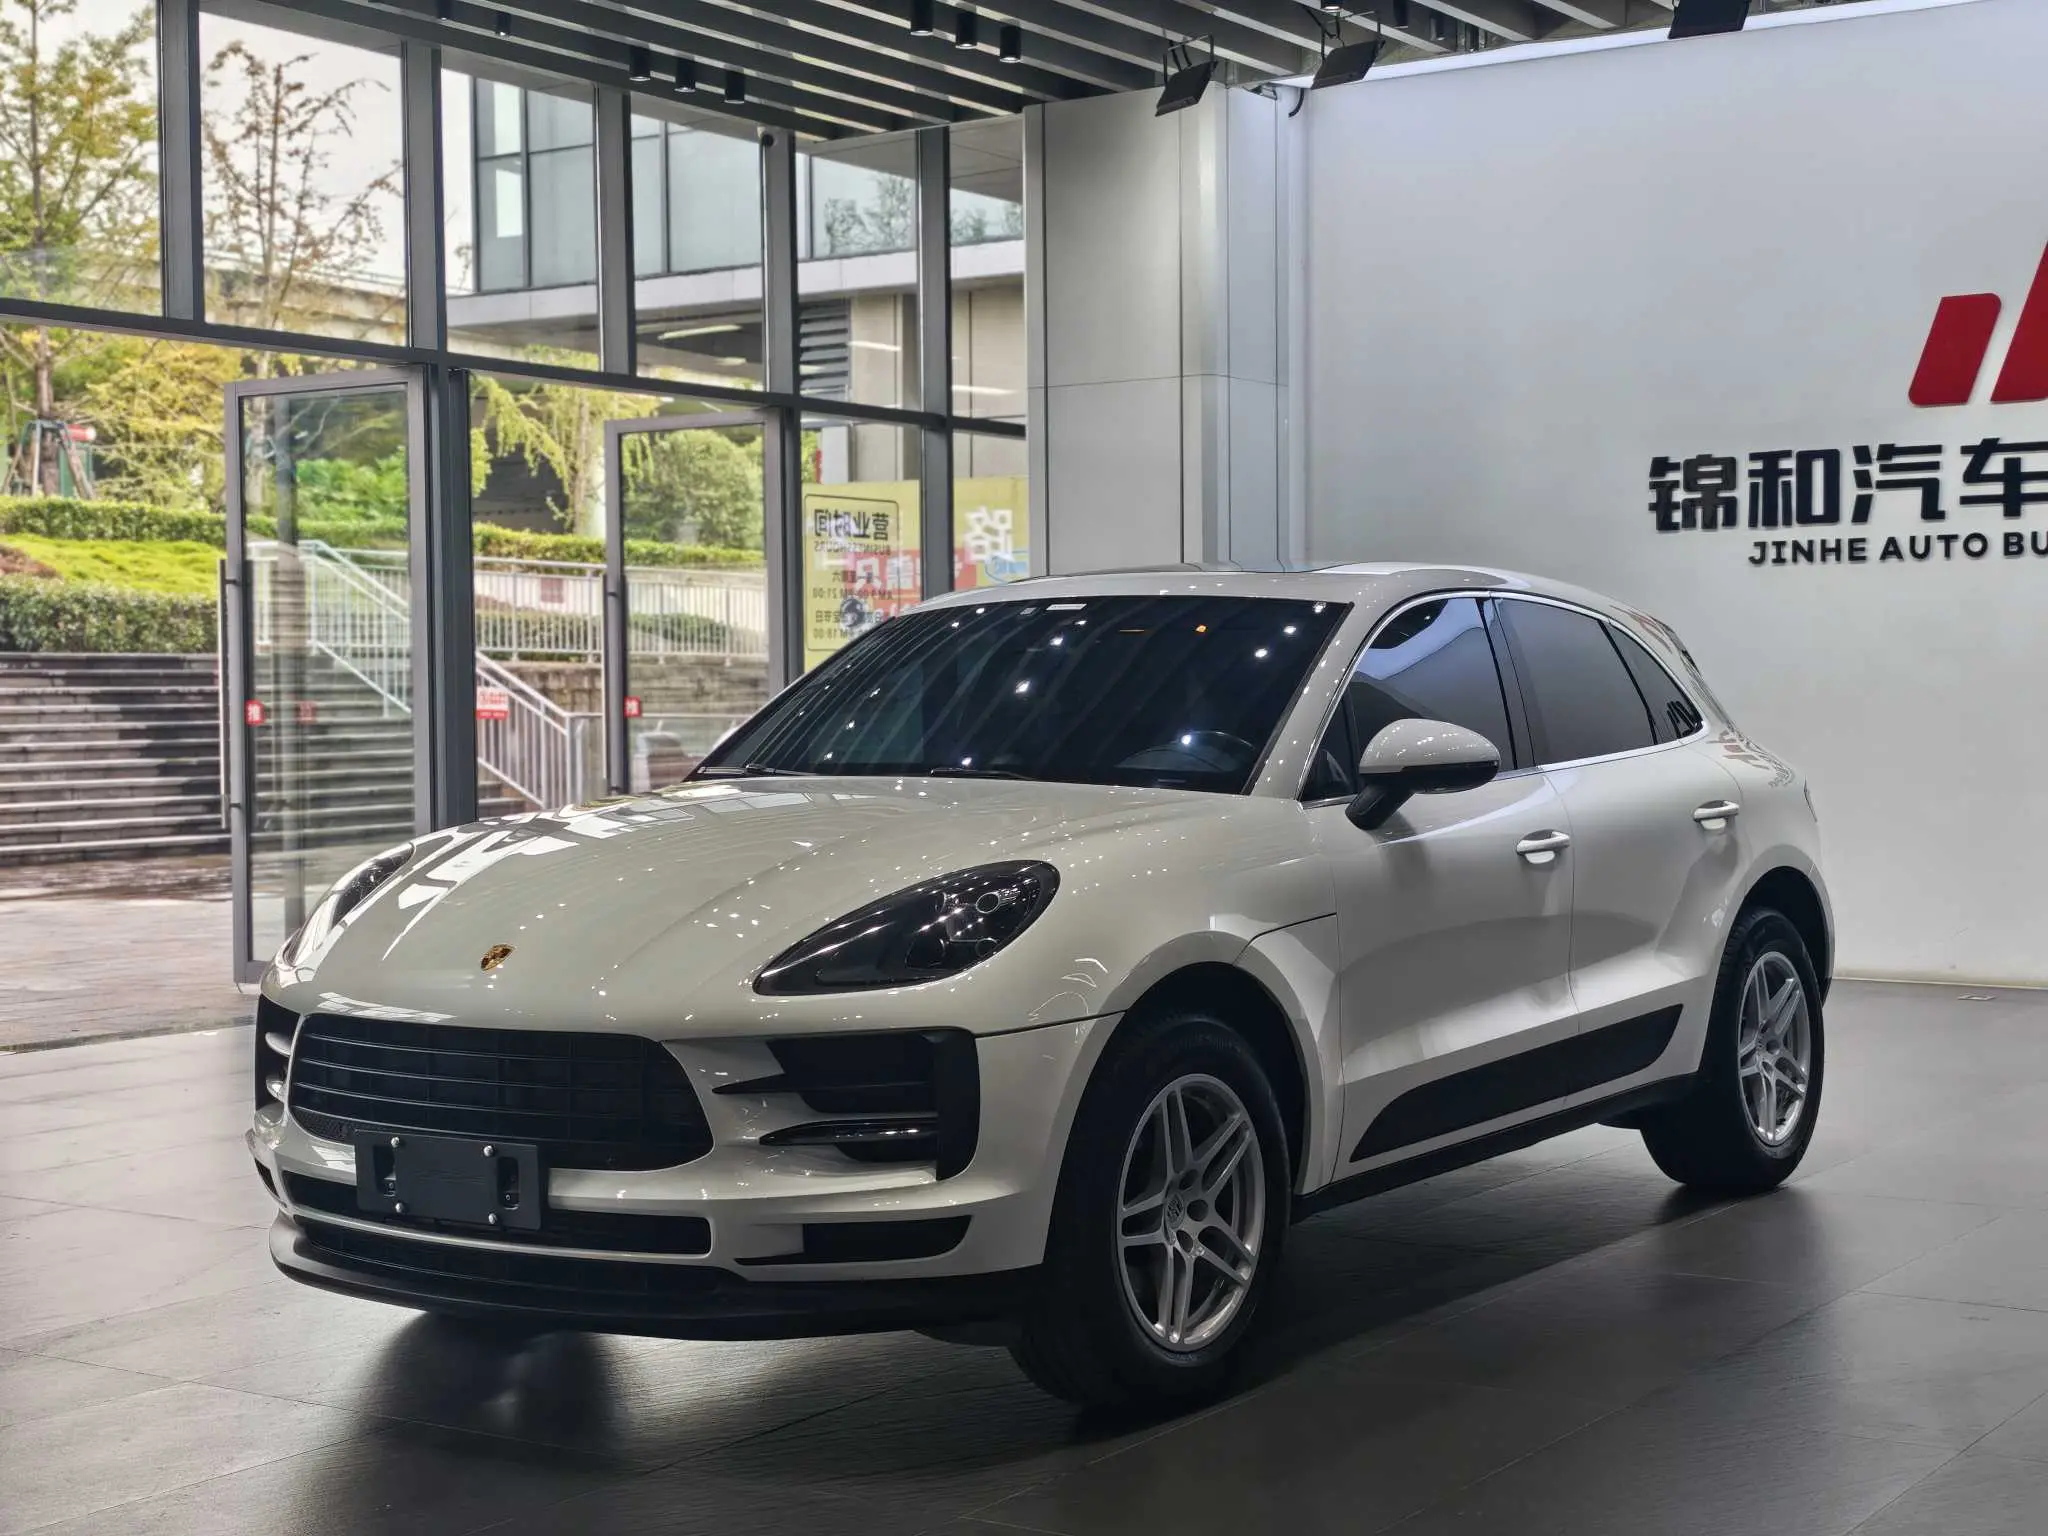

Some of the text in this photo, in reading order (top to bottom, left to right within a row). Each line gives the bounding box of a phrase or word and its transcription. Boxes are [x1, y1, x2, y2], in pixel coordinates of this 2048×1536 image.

[1648, 438, 2048, 531] 锦和汽车
[1748, 537, 1868, 565] JINHE
[1879, 532, 1989, 562] AUTO
